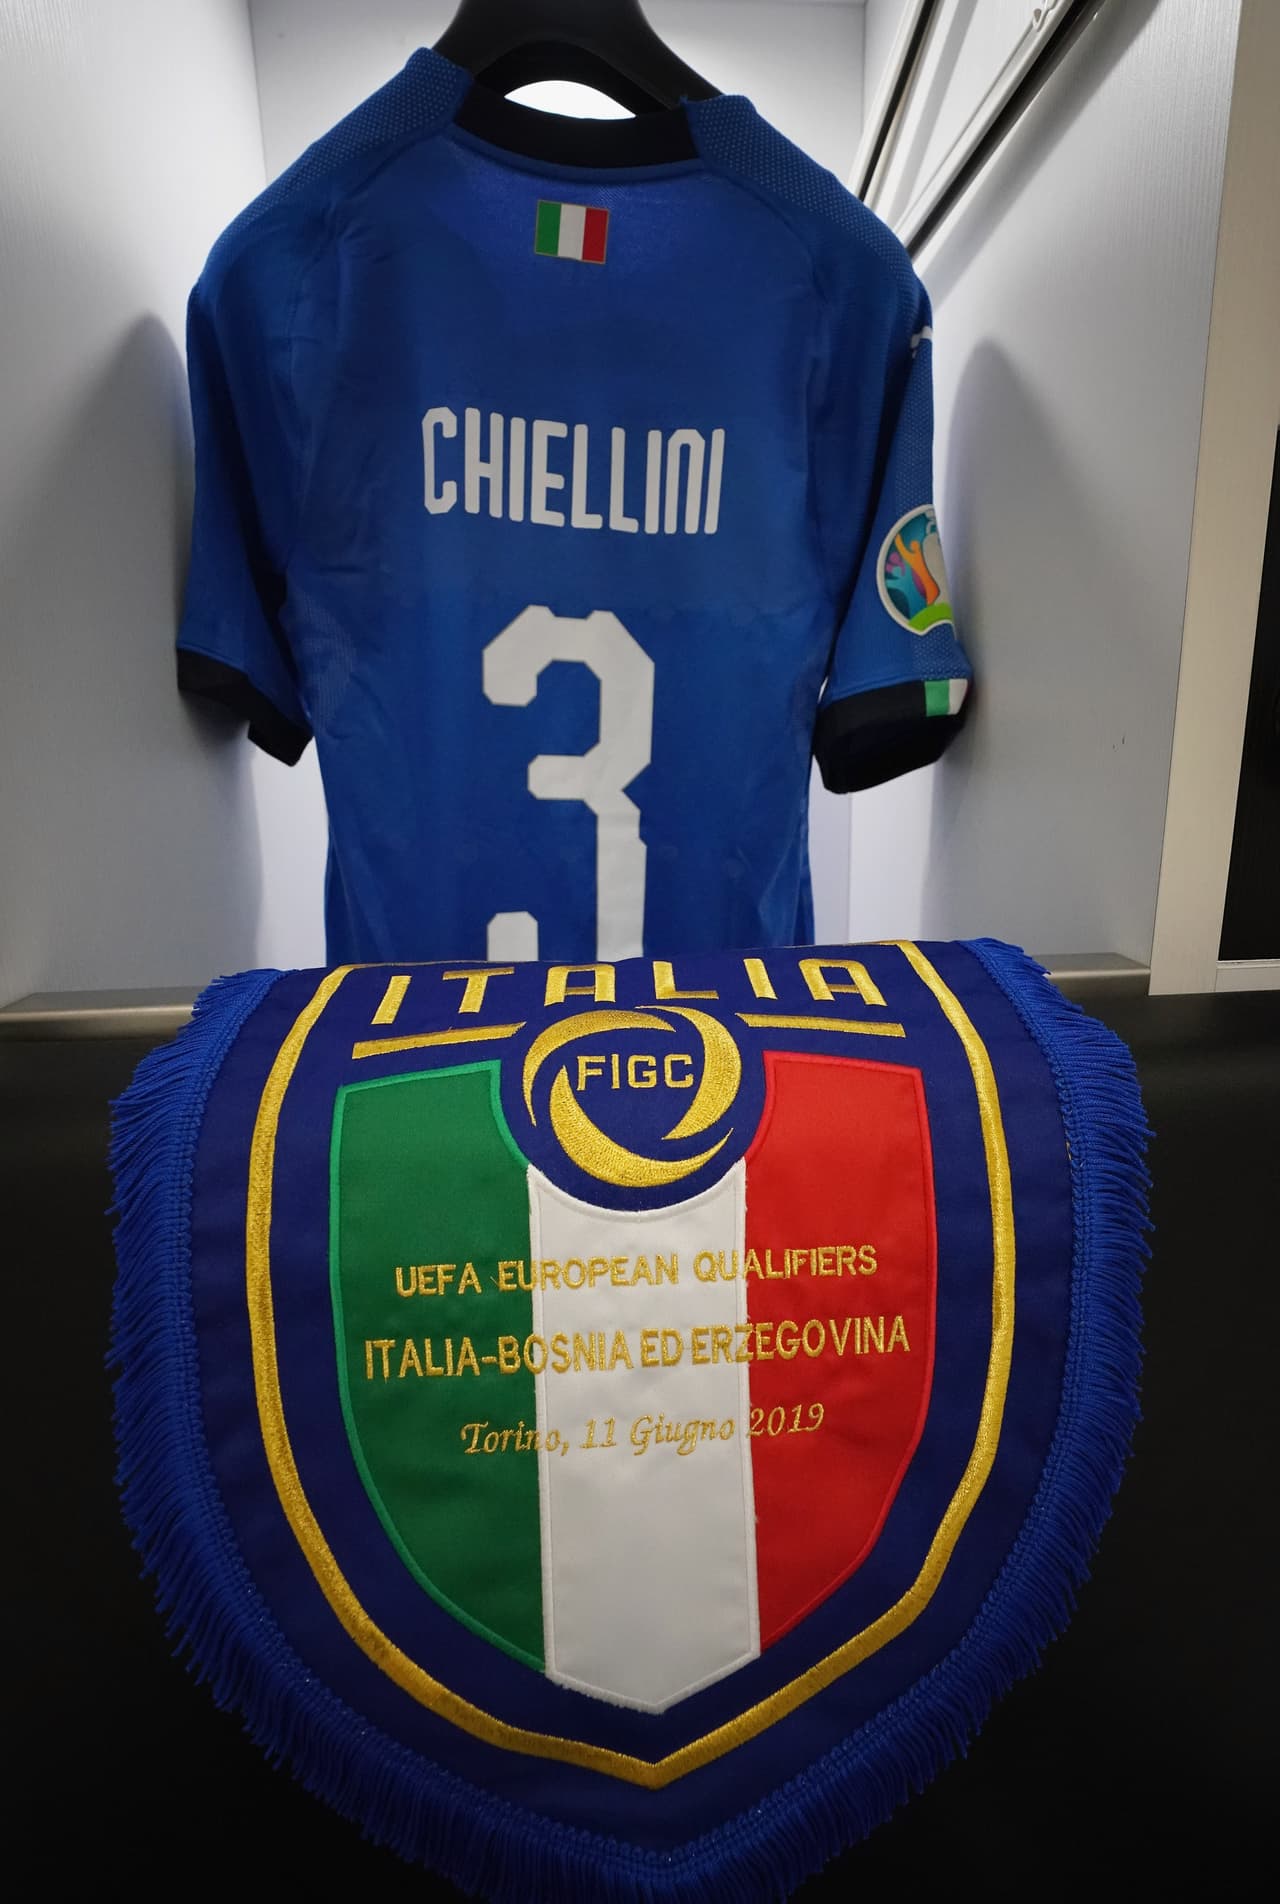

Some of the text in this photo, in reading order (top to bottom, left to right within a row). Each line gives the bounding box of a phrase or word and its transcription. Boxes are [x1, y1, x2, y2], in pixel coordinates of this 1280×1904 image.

[422, 406, 725, 534] CHIELLINI
[482, 604, 655, 961] 3
[370, 958, 888, 1025] ITALIA
[576, 1053, 695, 1092] FIGC
[395, 1244, 878, 1298] UEFA EUROPEAN QUALIFIERS
[364, 1315, 911, 1381] ITALIA-BOSNIA ED ERZEGOVINA
[460, 1402, 825, 1456] Torino, 11 Giugno 2019
